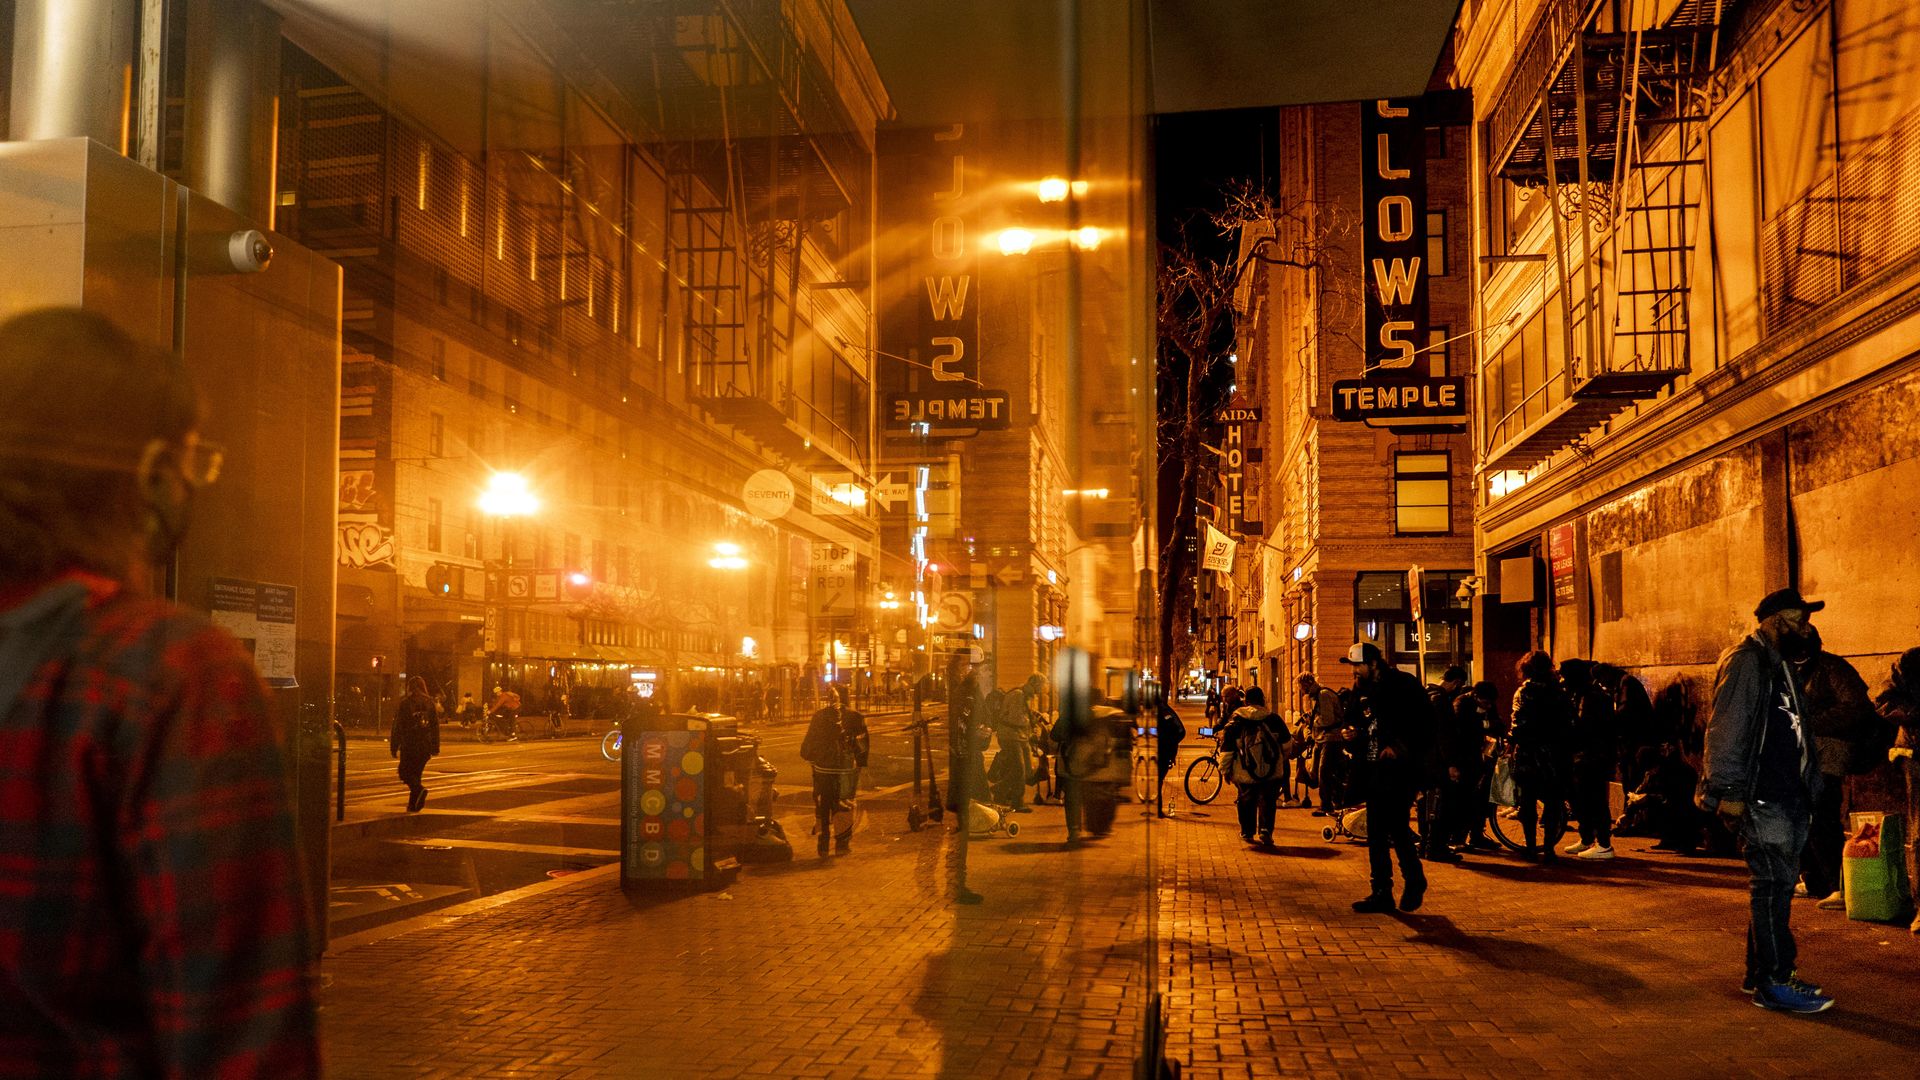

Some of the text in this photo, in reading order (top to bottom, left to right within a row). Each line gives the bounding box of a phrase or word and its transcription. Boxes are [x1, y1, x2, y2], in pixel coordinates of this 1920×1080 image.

[1339, 384, 1456, 410] TEMPLE
[1219, 409, 1258, 421] AIDA
[748, 490, 790, 499] SEVENTH
[875, 488, 906, 496] ONE WAY
[813, 547, 850, 561] STOP
[811, 564, 852, 573] HERE ON
[818, 577, 846, 589] RED
[1411, 633, 1431, 642] 105
